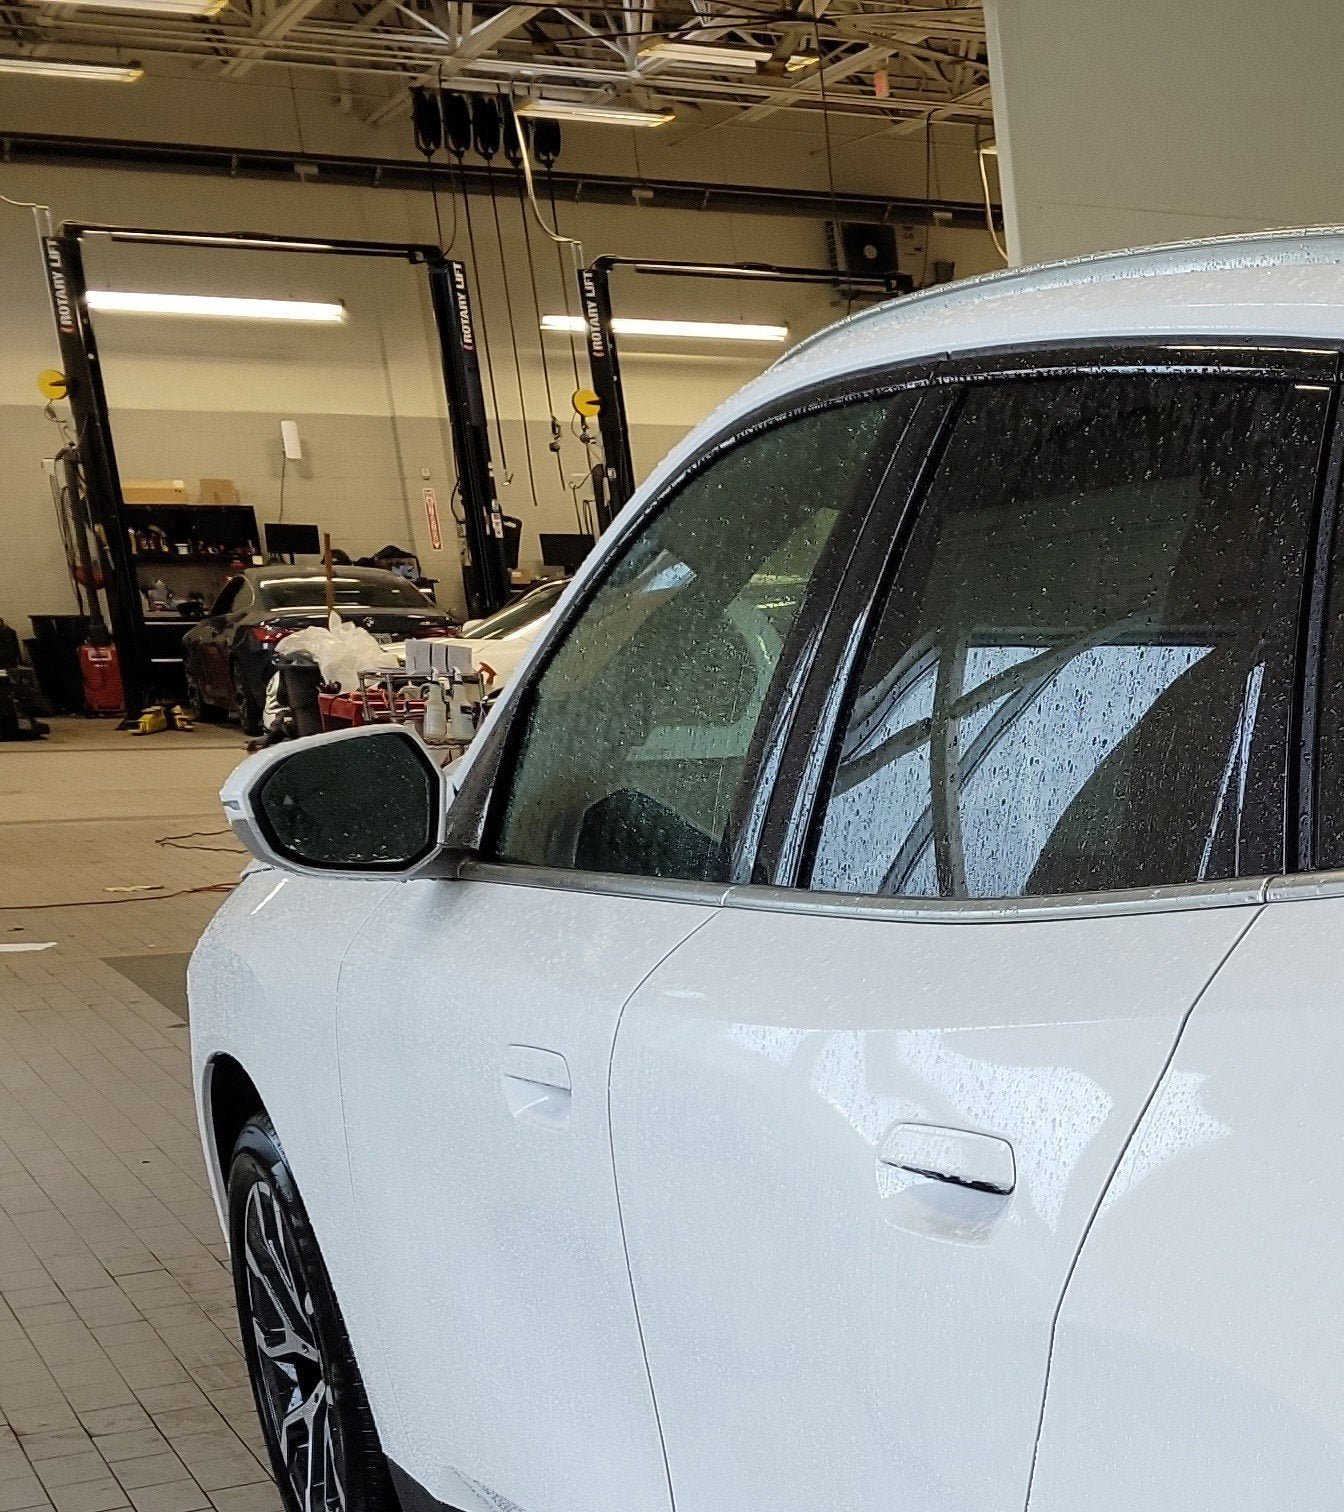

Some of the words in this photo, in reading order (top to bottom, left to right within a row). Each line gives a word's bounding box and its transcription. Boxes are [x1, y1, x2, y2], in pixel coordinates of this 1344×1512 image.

[46, 238, 61, 268] LIFT
[453, 261, 465, 290] LIFT
[583, 269, 596, 298] LIFT
[51, 271, 73, 325] ROTARY
[457, 291, 473, 344] ROTARY
[587, 300, 604, 351] ROTARY
